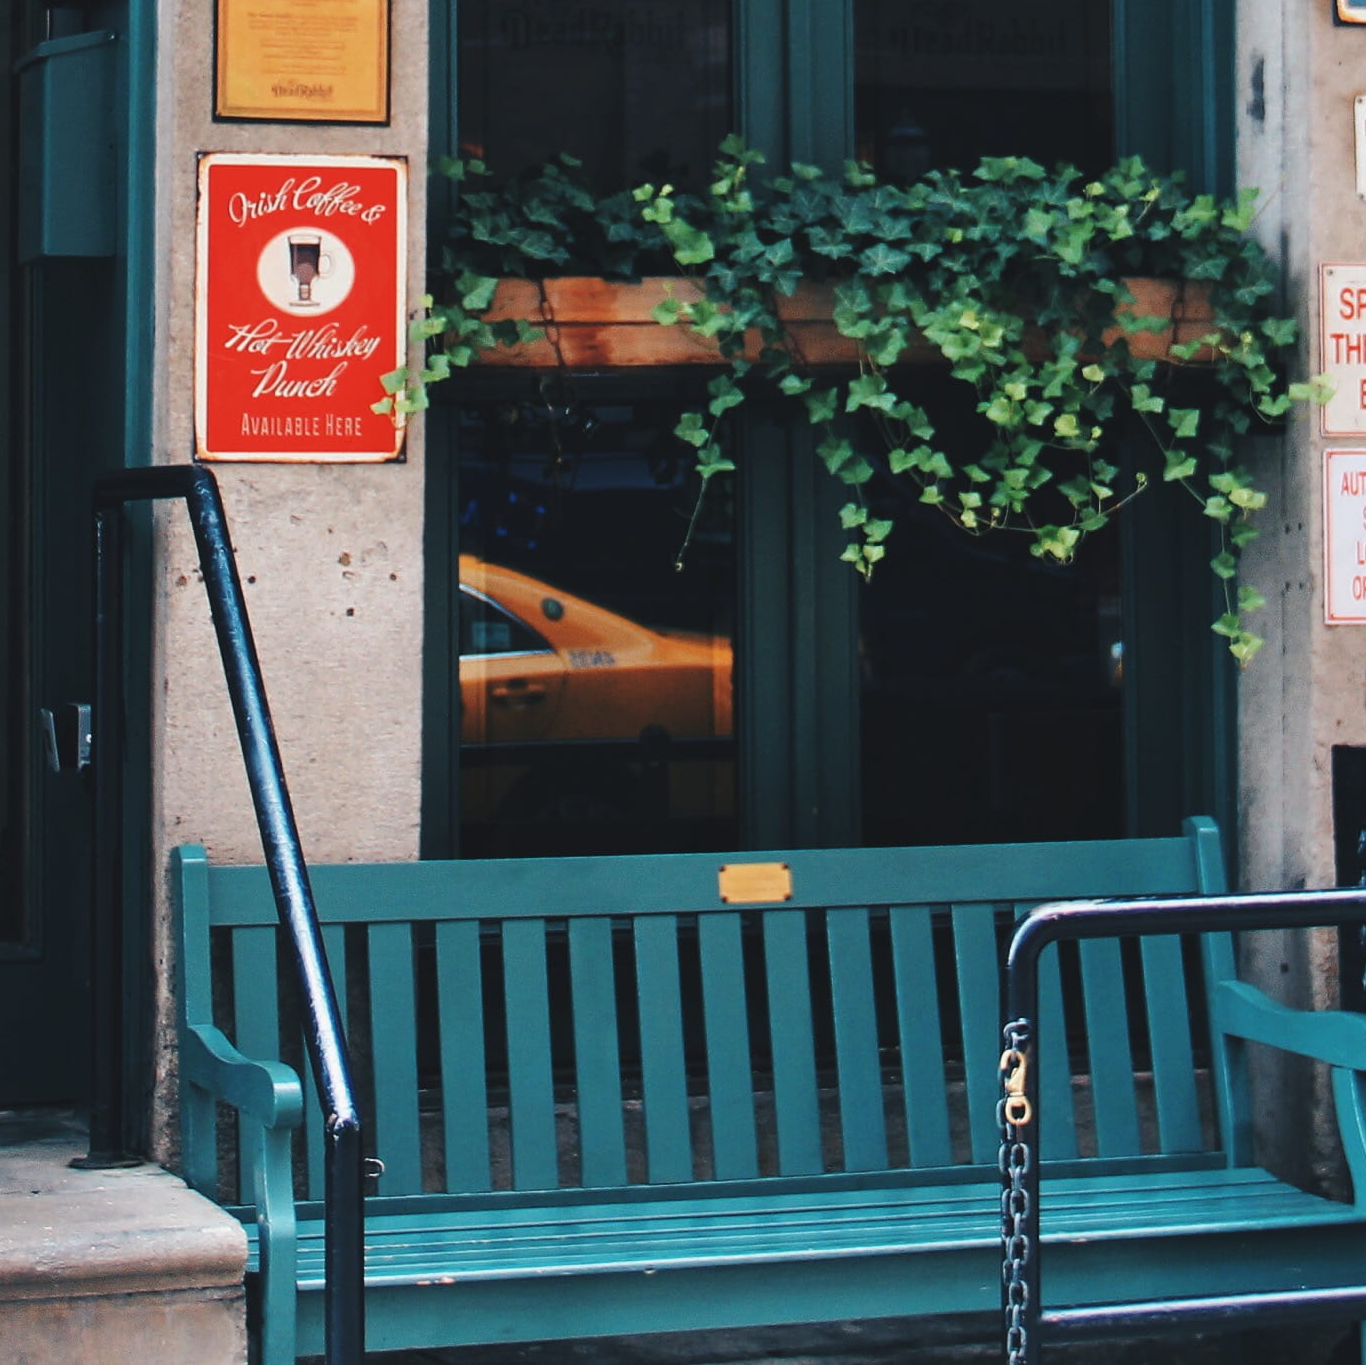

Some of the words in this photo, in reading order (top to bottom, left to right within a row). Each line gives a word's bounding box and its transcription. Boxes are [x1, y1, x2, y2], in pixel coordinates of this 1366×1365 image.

[228, 177, 294, 227] Irish
[292, 176, 362, 217] Coffee
[360, 204, 387, 225] &
[224, 318, 291, 353] Hot
[286, 322, 382, 361] Whiskey
[250, 360, 348, 399] Punch
[241, 413, 320, 437] AVAILABLE
[325, 414, 363, 437] HERE
